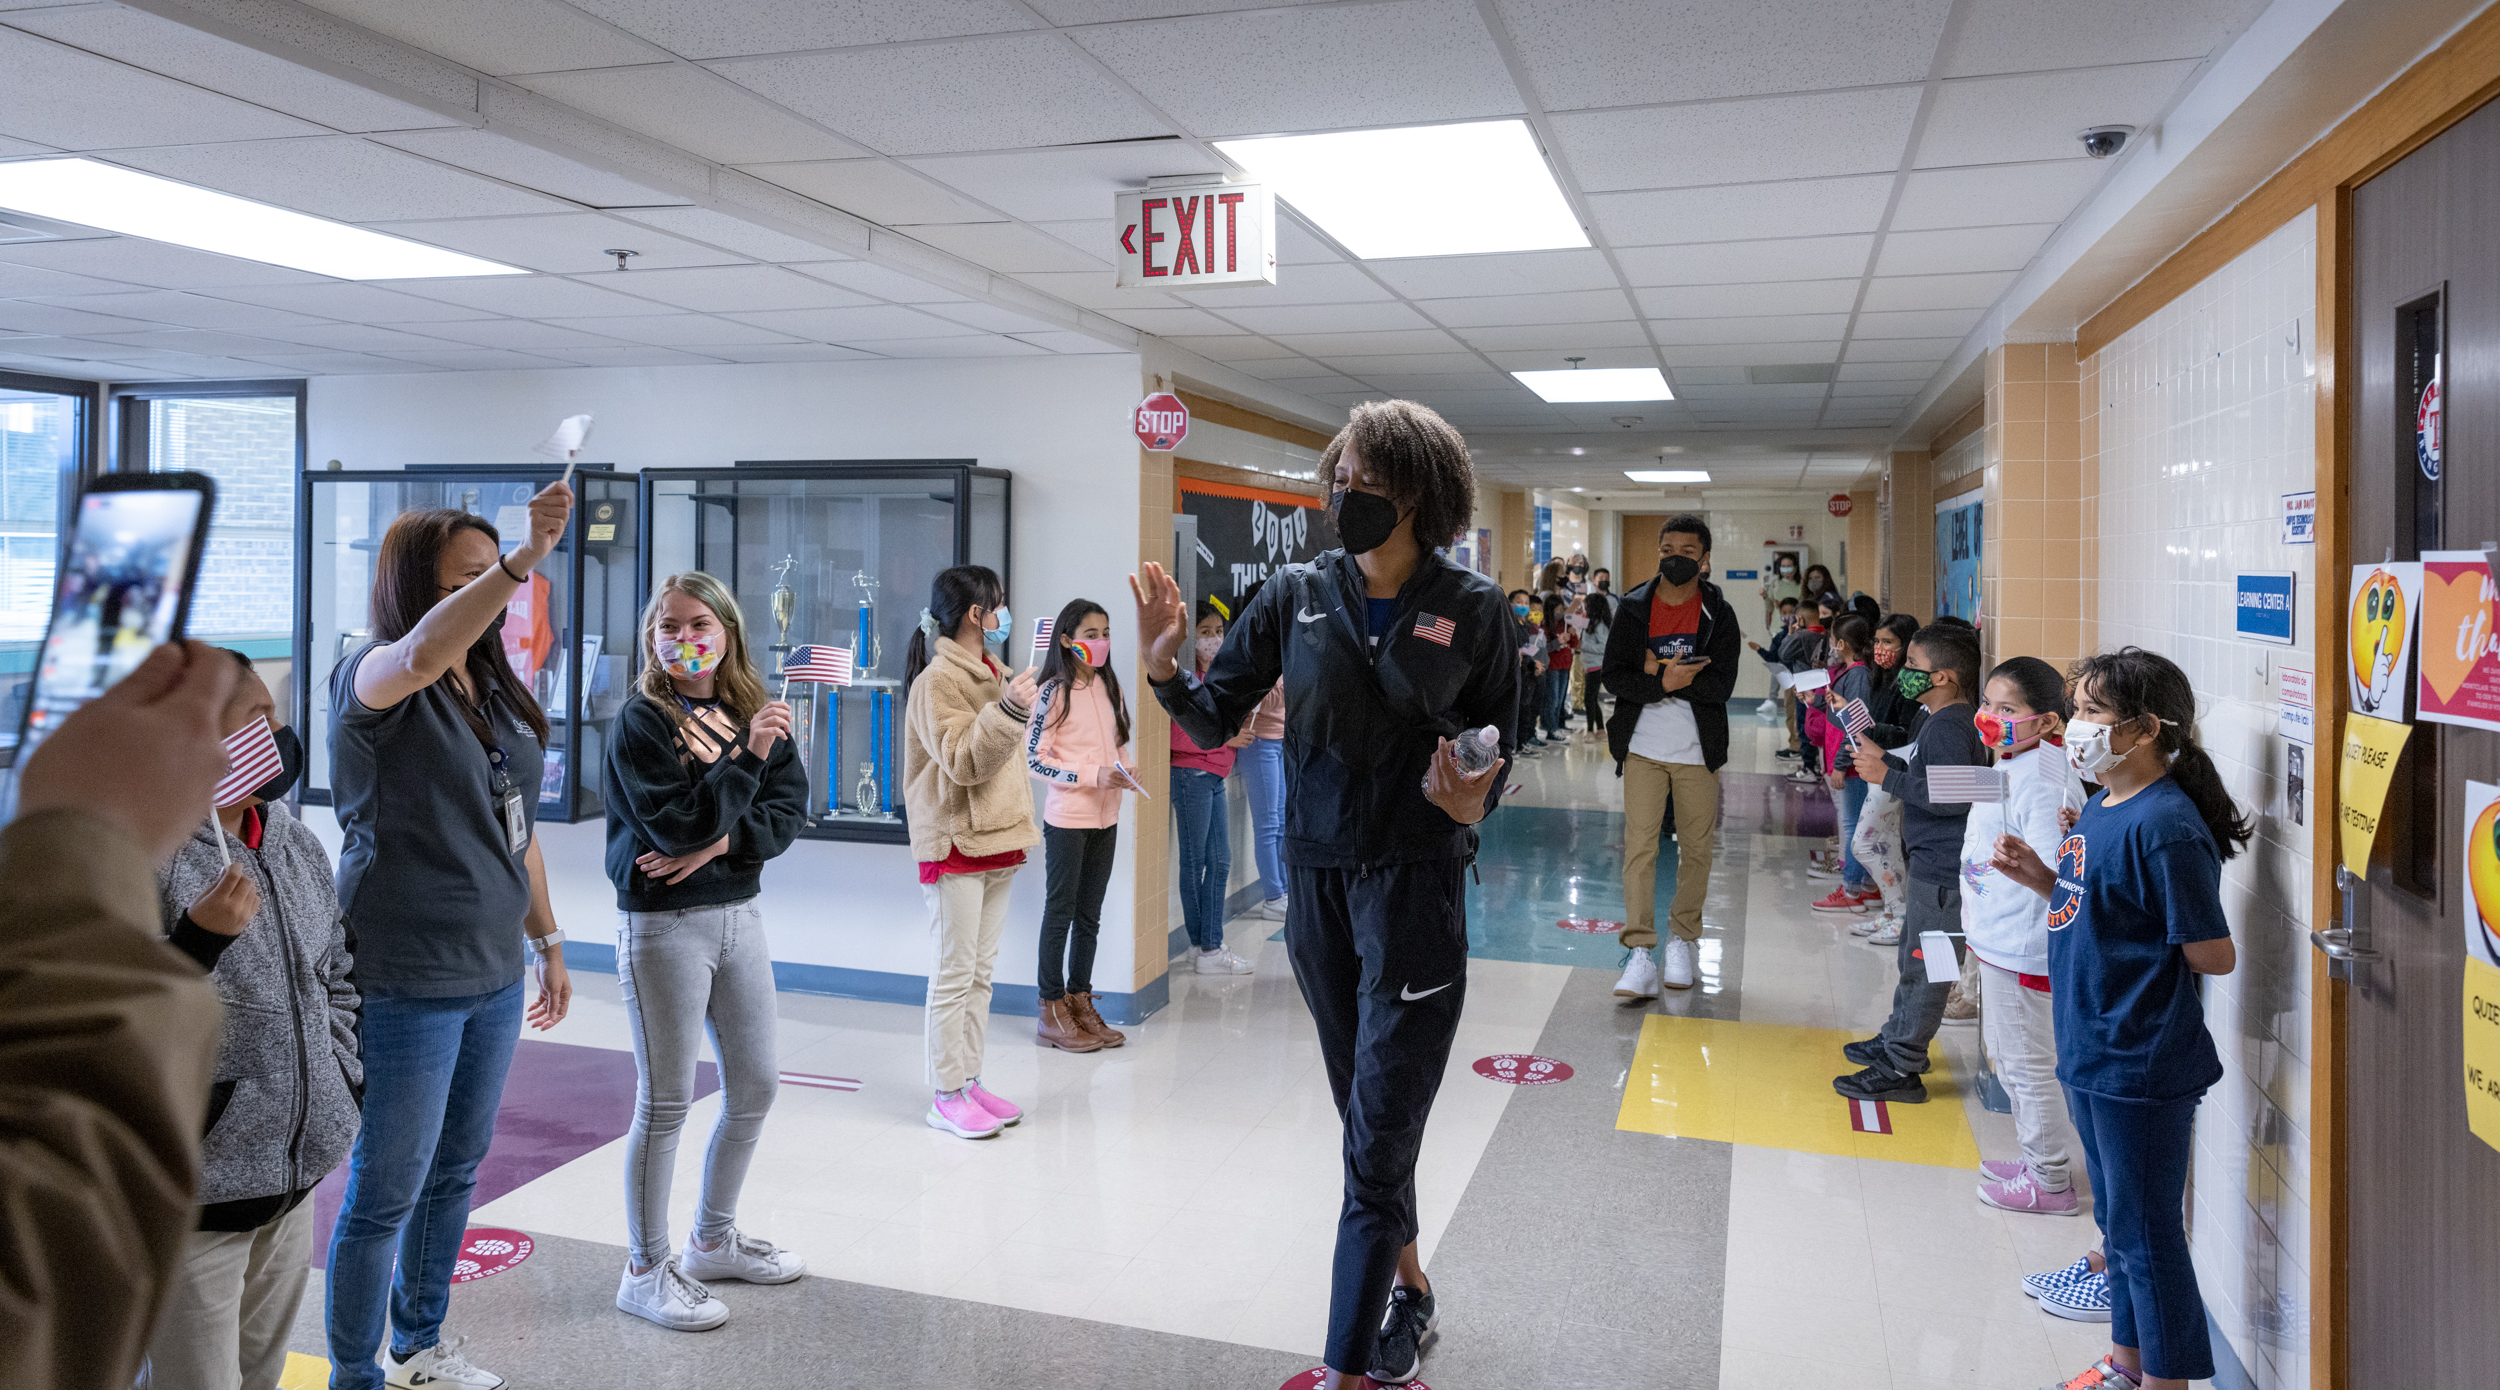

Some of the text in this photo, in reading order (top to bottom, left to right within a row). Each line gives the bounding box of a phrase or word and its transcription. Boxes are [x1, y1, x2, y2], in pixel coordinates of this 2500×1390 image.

[1142, 192, 1244, 277] EXIT
[1138, 410, 1184, 434] STOP
[1829, 500, 1851, 511] STOP
[1254, 502, 1305, 550] 2021
[2237, 591, 2290, 611] LEARNING CENTER A
[2456, 609, 2500, 662] tha
[1658, 645, 1694, 654] HOLLISTER
[1028, 713, 1045, 753] ADIDAS
[2346, 742, 2389, 769] QUIET PLEASE
[2350, 809, 2376, 835] TESTING
[2055, 877, 2087, 895] runners
[2472, 995, 2500, 1026] QUIE
[2466, 1064, 2483, 1091] WE
[460, 1240, 532, 1282] STAND HERE
